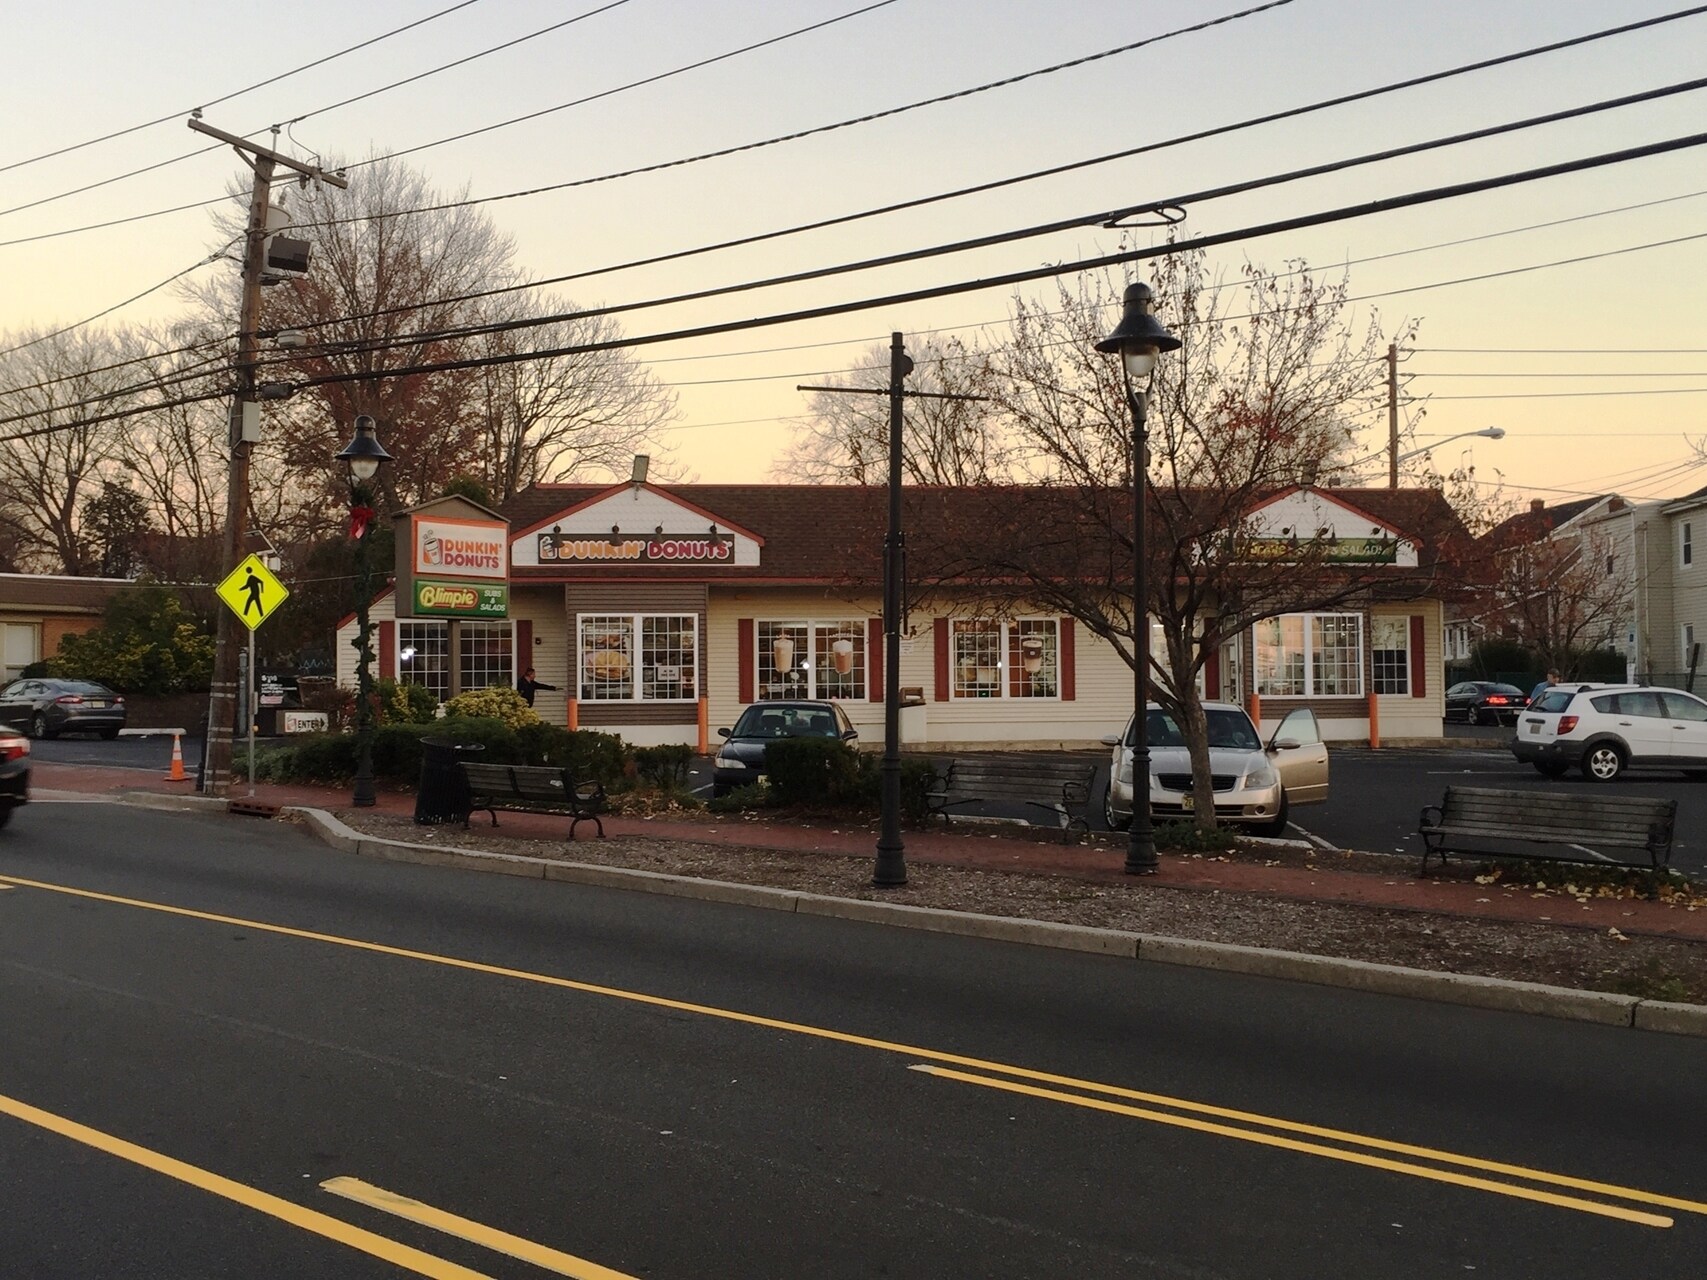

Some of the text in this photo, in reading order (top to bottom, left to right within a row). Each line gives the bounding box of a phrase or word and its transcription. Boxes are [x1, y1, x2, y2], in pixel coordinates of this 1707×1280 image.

[445, 540, 502, 555] DUNKIN'
[559, 540, 728, 560] DUNKIN' DONUTS
[445, 553, 499, 568] DONUTS
[420, 587, 474, 608] Blimpie
[298, 720, 319, 728] ENTER
